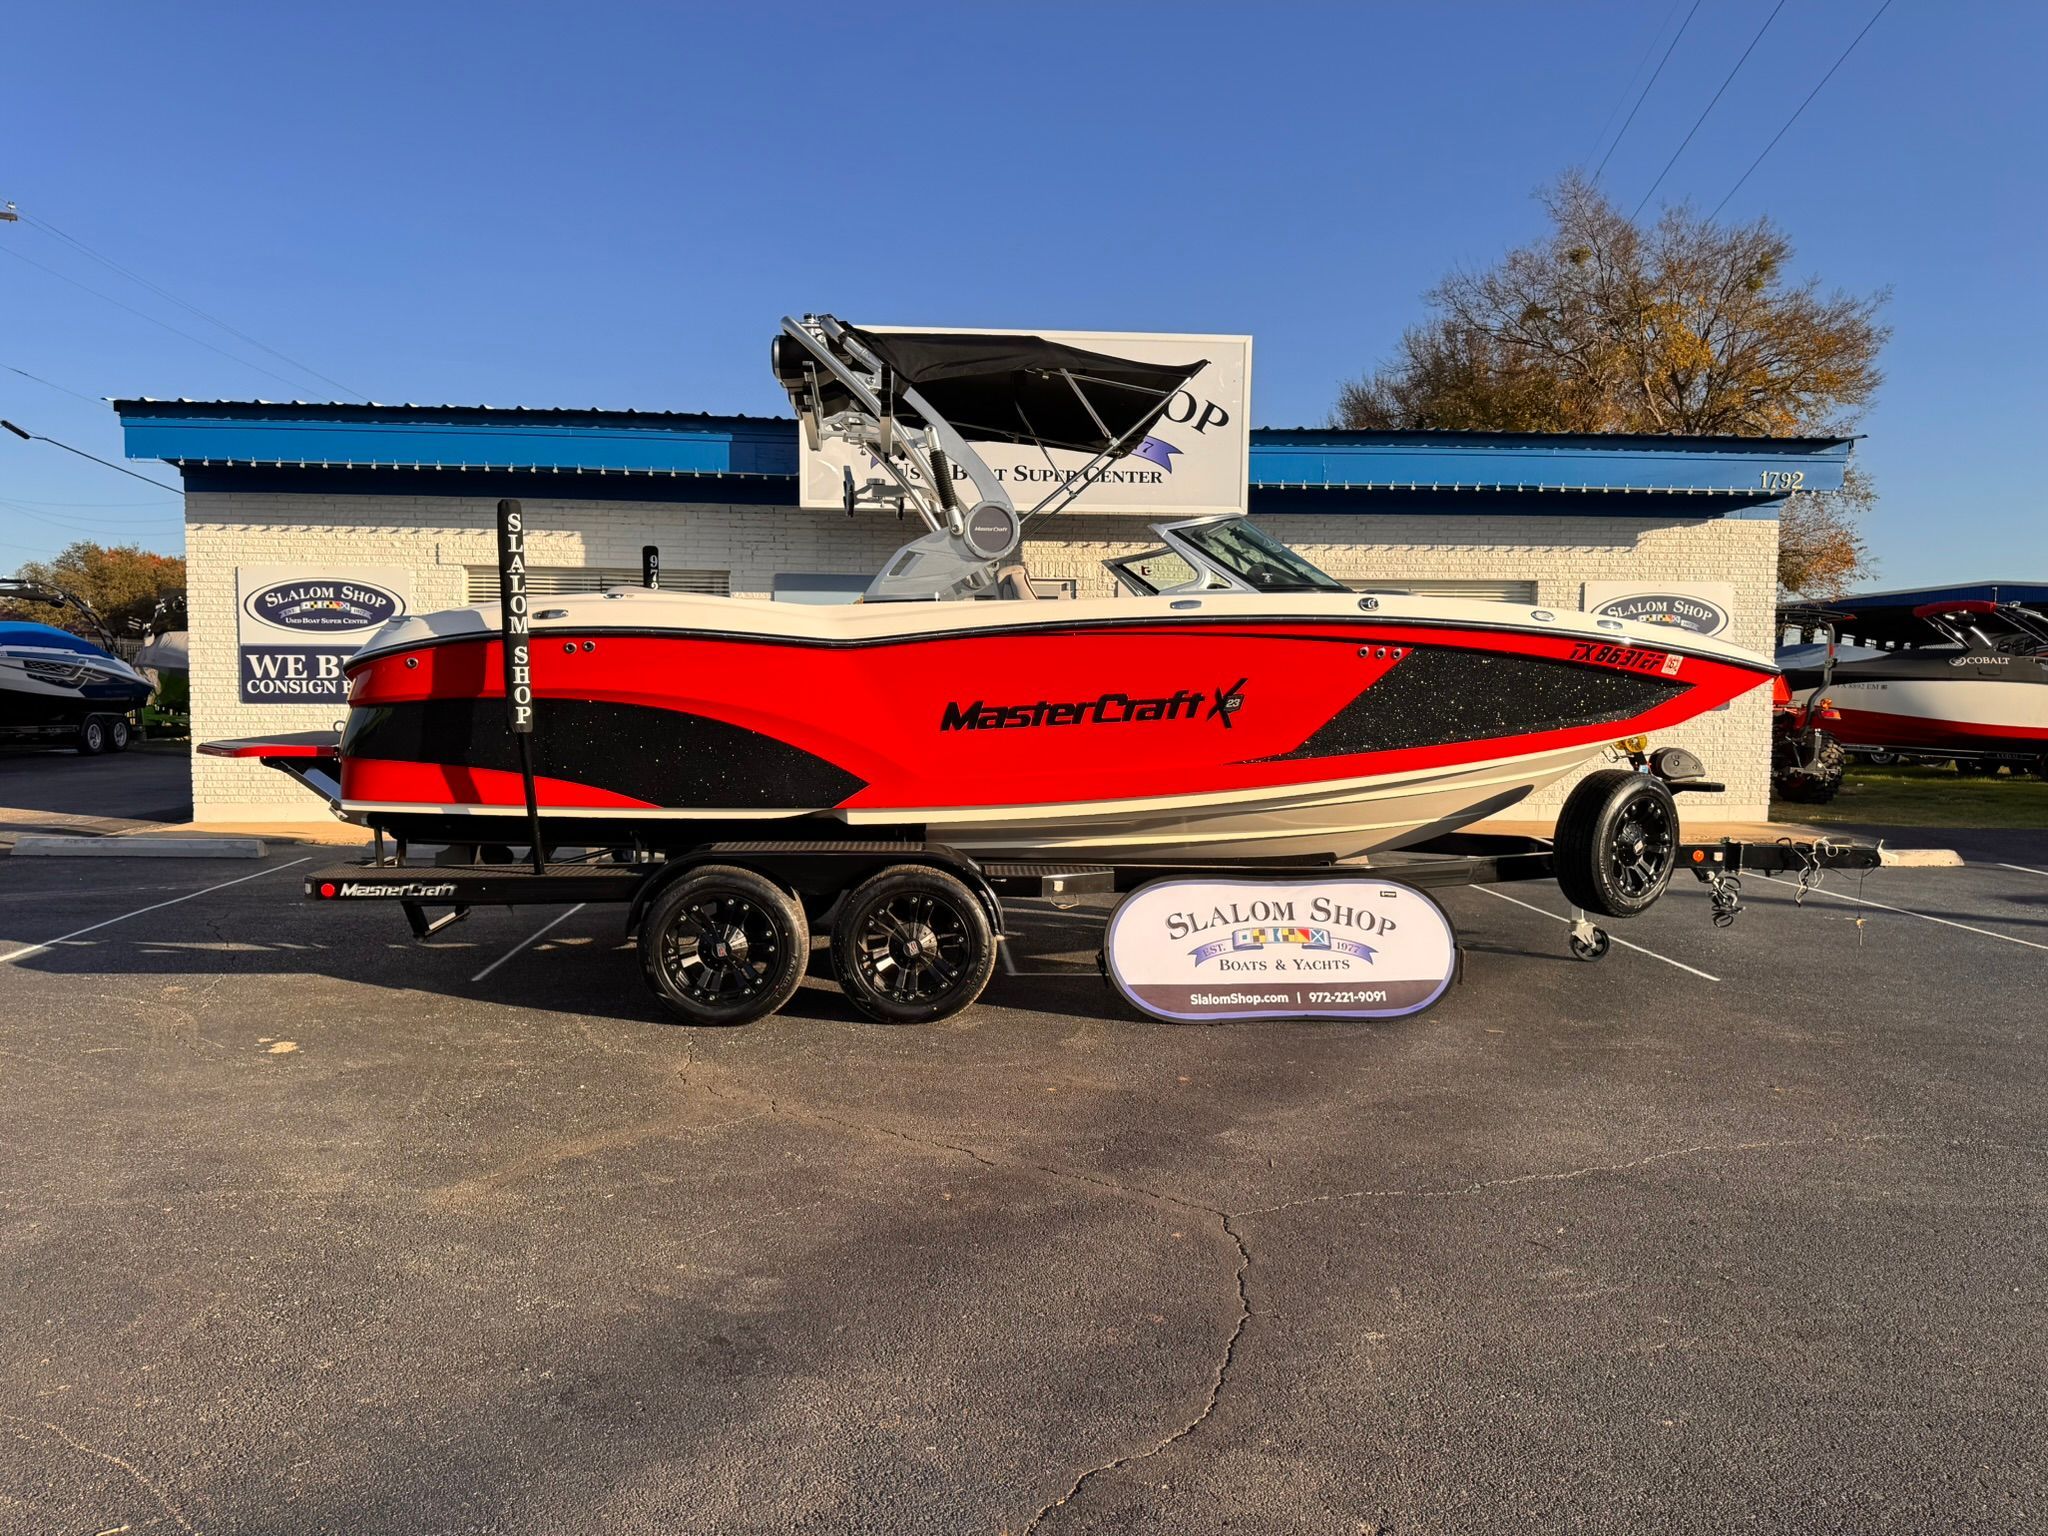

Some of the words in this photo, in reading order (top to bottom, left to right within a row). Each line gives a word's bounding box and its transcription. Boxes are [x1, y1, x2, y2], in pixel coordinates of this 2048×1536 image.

[1163, 389, 1230, 434] OP
[1013, 465, 1079, 482] SUPER
[1083, 466, 1163, 484] CENTER
[1760, 470, 1804, 490] 1792
[507, 513, 529, 634] SLALOM
[264, 586, 334, 607] SLALOM
[341, 586, 387, 608] SHOP
[1607, 601, 1668, 618] SLALOM
[1673, 600, 1713, 620] SHOP
[246, 654, 308, 679] WE
[1965, 656, 2011, 665] COBALT
[246, 679, 338, 694] CONSIGN
[513, 646, 532, 724] SHOP
[940, 690, 1205, 731] MasterCraft
[340, 883, 458, 897] MasterCraft
[1165, 900, 1296, 940] SLALOM
[1310, 897, 1397, 937] SHOP
[1202, 943, 1226, 957] EST.
[1336, 941, 1361, 954] 1977
[1219, 958, 1267, 971] BOATS
[1275, 959, 1286, 970] &
[1293, 958, 1350, 970] YACHTS
[1190, 992, 1289, 1006] SlalomShop.com
[1308, 991, 1387, 1004] 972-221-9091
